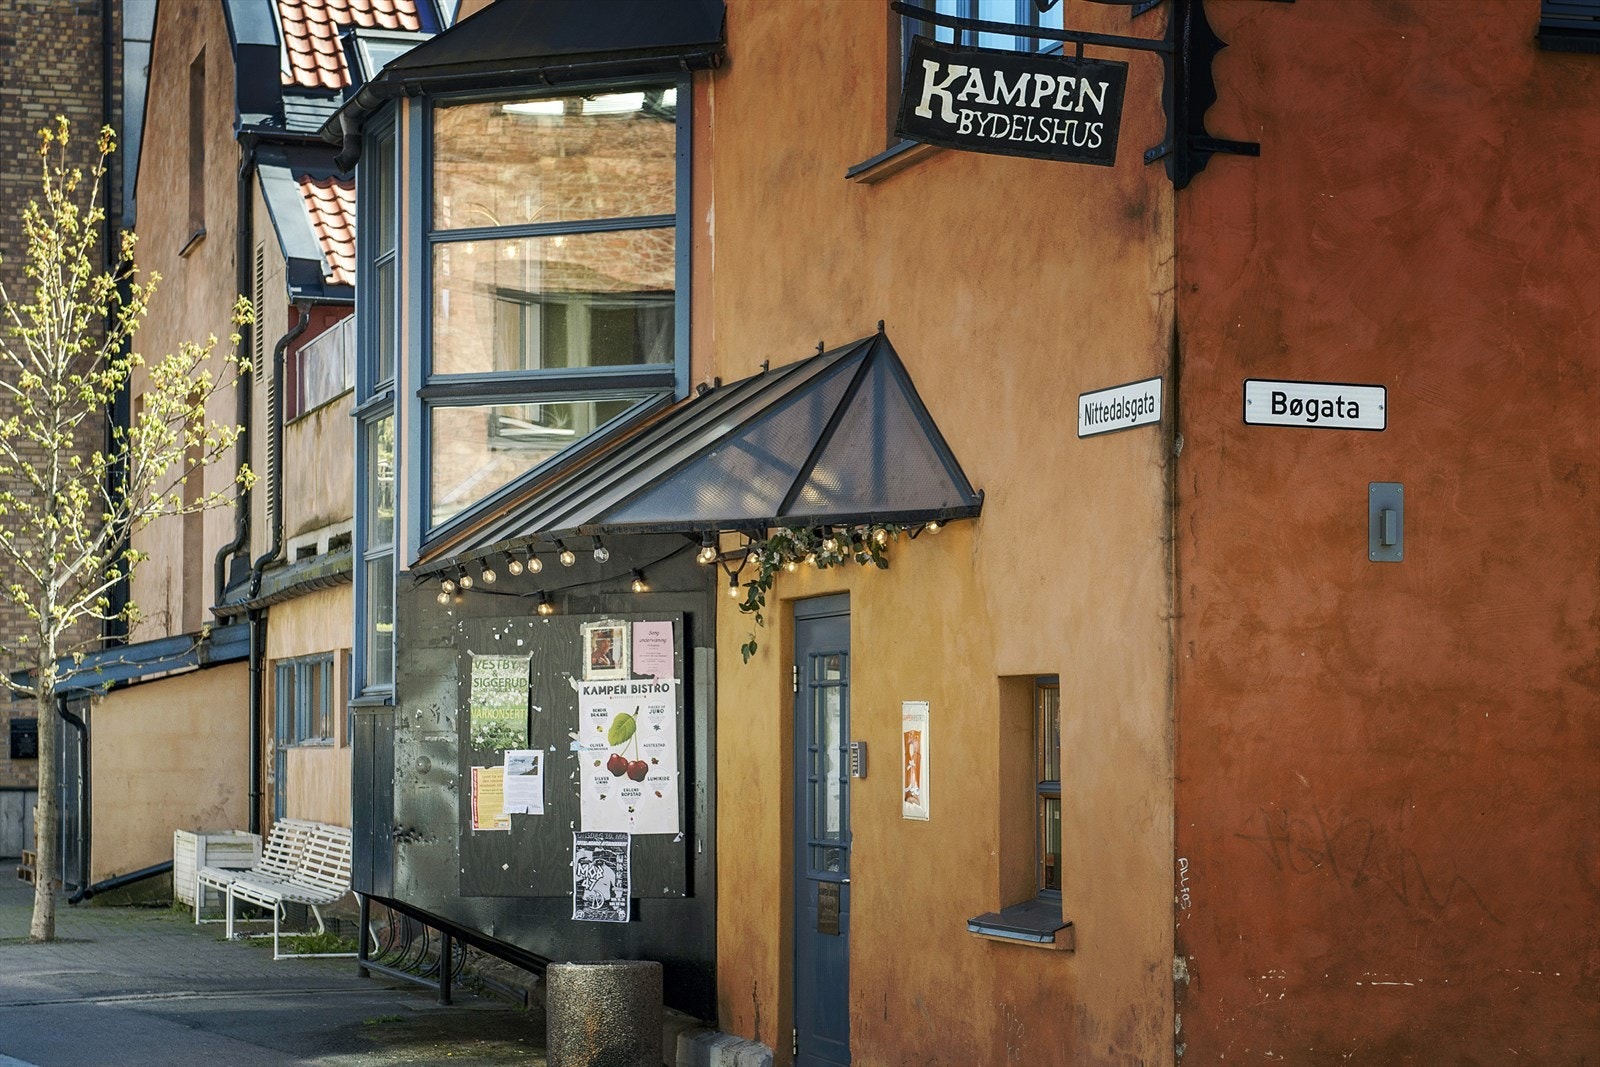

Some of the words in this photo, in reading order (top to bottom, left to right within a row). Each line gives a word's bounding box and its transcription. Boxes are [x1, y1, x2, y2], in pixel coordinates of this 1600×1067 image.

[915, 58, 1109, 123] KAMPEN
[956, 108, 1104, 149] BYDELSHUS
[1083, 393, 1155, 427] Nittedalsgata
[1270, 390, 1360, 423] Bøgata
[474, 659, 517, 670] VESTBY
[473, 677, 528, 688] SIGGERUD
[583, 684, 627, 696] KAMPEN
[630, 683, 670, 694] BISTRO
[577, 862, 604, 880] MOB
[581, 878, 598, 891] 47
